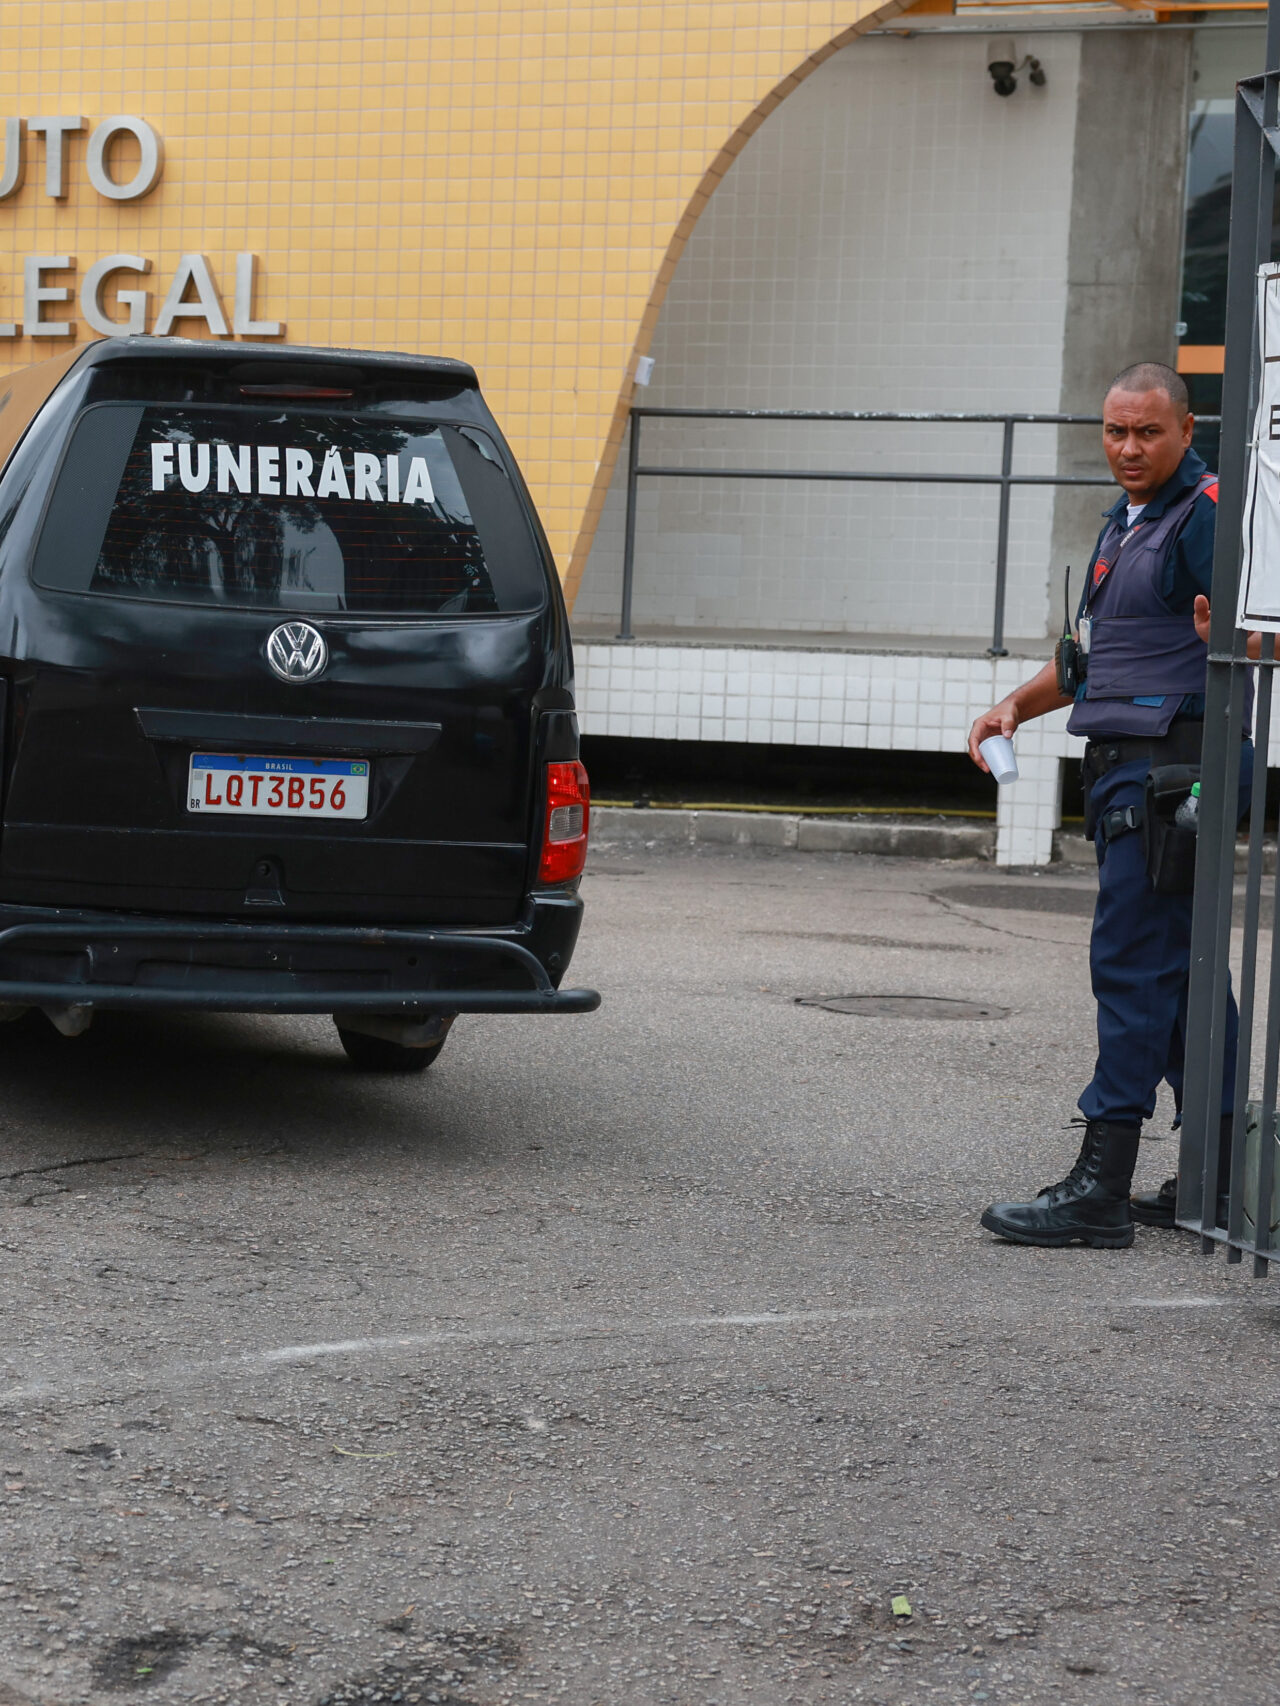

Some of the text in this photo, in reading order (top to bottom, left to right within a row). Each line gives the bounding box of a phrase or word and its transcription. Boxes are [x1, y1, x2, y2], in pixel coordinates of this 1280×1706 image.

[150, 442, 436, 504] FUNERÁRIA
[265, 762, 294, 771] BRASIL
[190, 798, 201, 809] BR
[205, 773, 346, 811] LQT3B56
